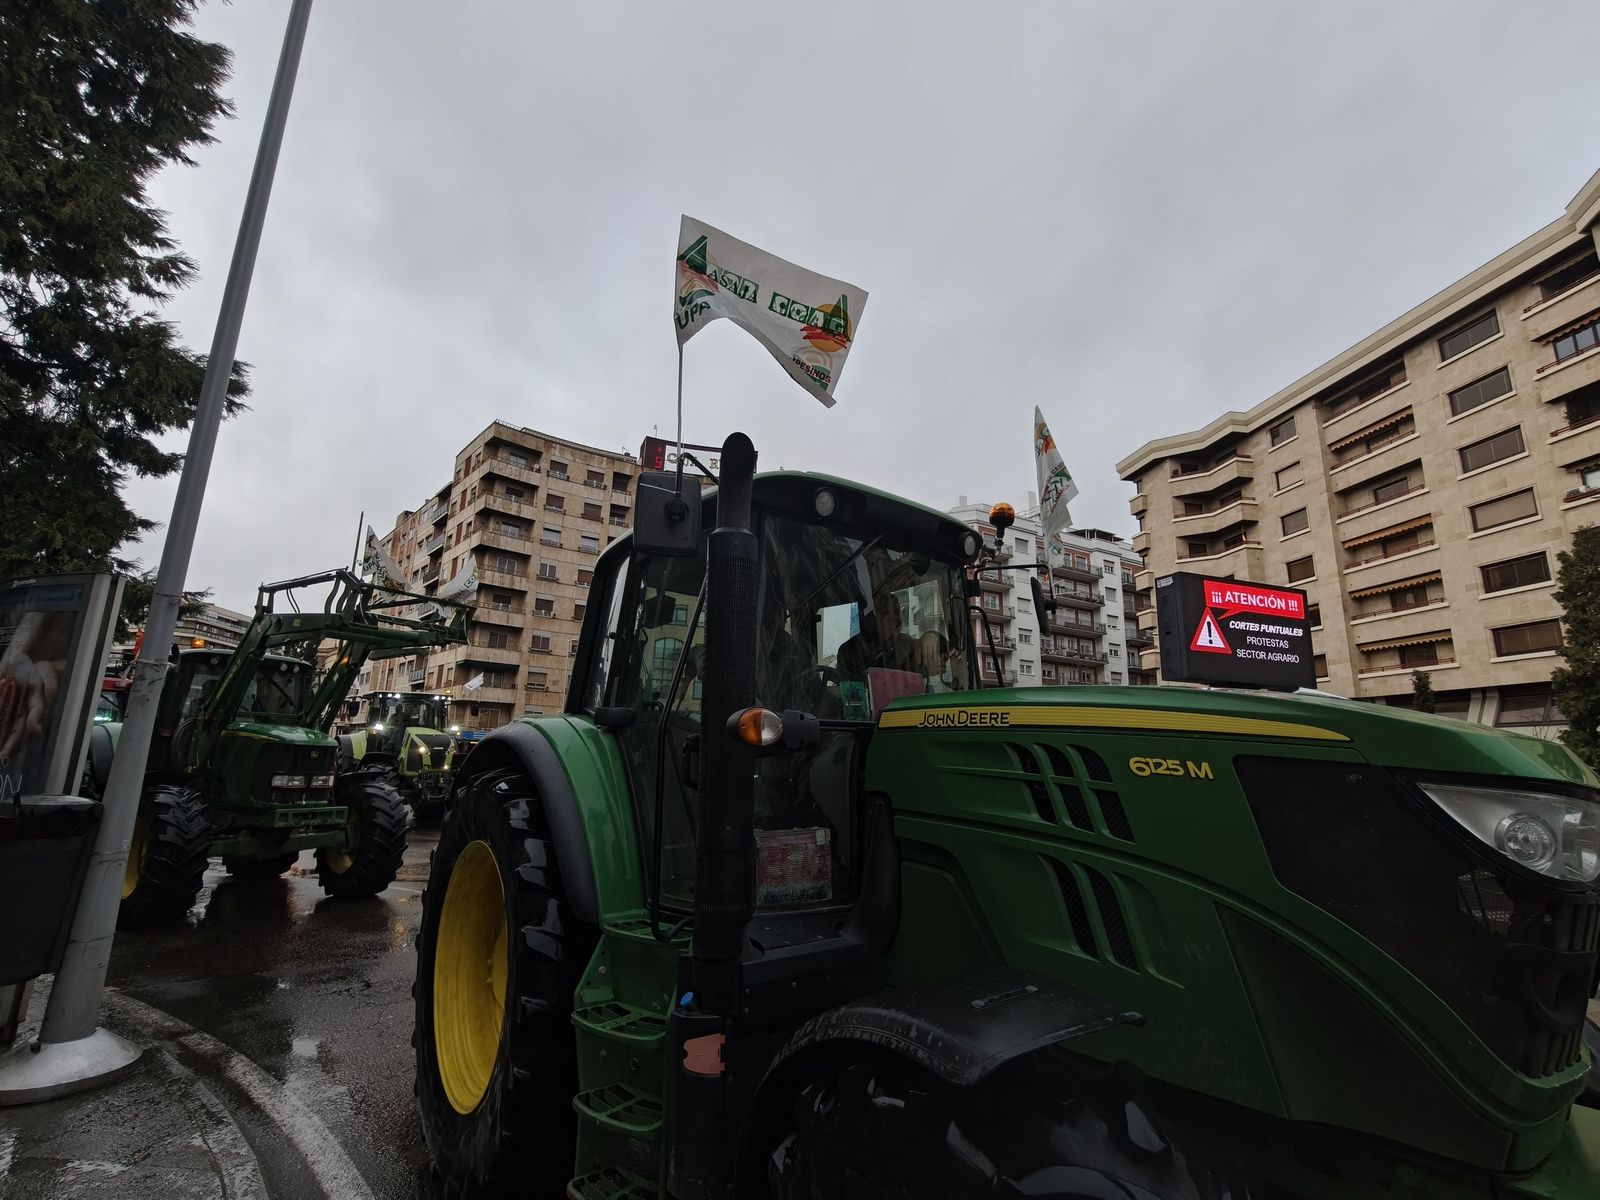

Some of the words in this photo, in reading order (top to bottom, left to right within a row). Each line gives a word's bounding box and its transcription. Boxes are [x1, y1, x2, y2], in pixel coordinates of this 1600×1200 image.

[768, 292, 844, 336] COAG
[1225, 591, 1286, 610] ATENCIÓN
[1229, 620, 1260, 632] CORTES
[1260, 624, 1304, 637] PUNTUALES
[1246, 636, 1289, 649] PROTESTAS
[1236, 649, 1267, 660] SECTOR
[1267, 653, 1300, 664] AGRARIO
[1128, 756, 1185, 778] 6125
[1186, 760, 1215, 780] M
